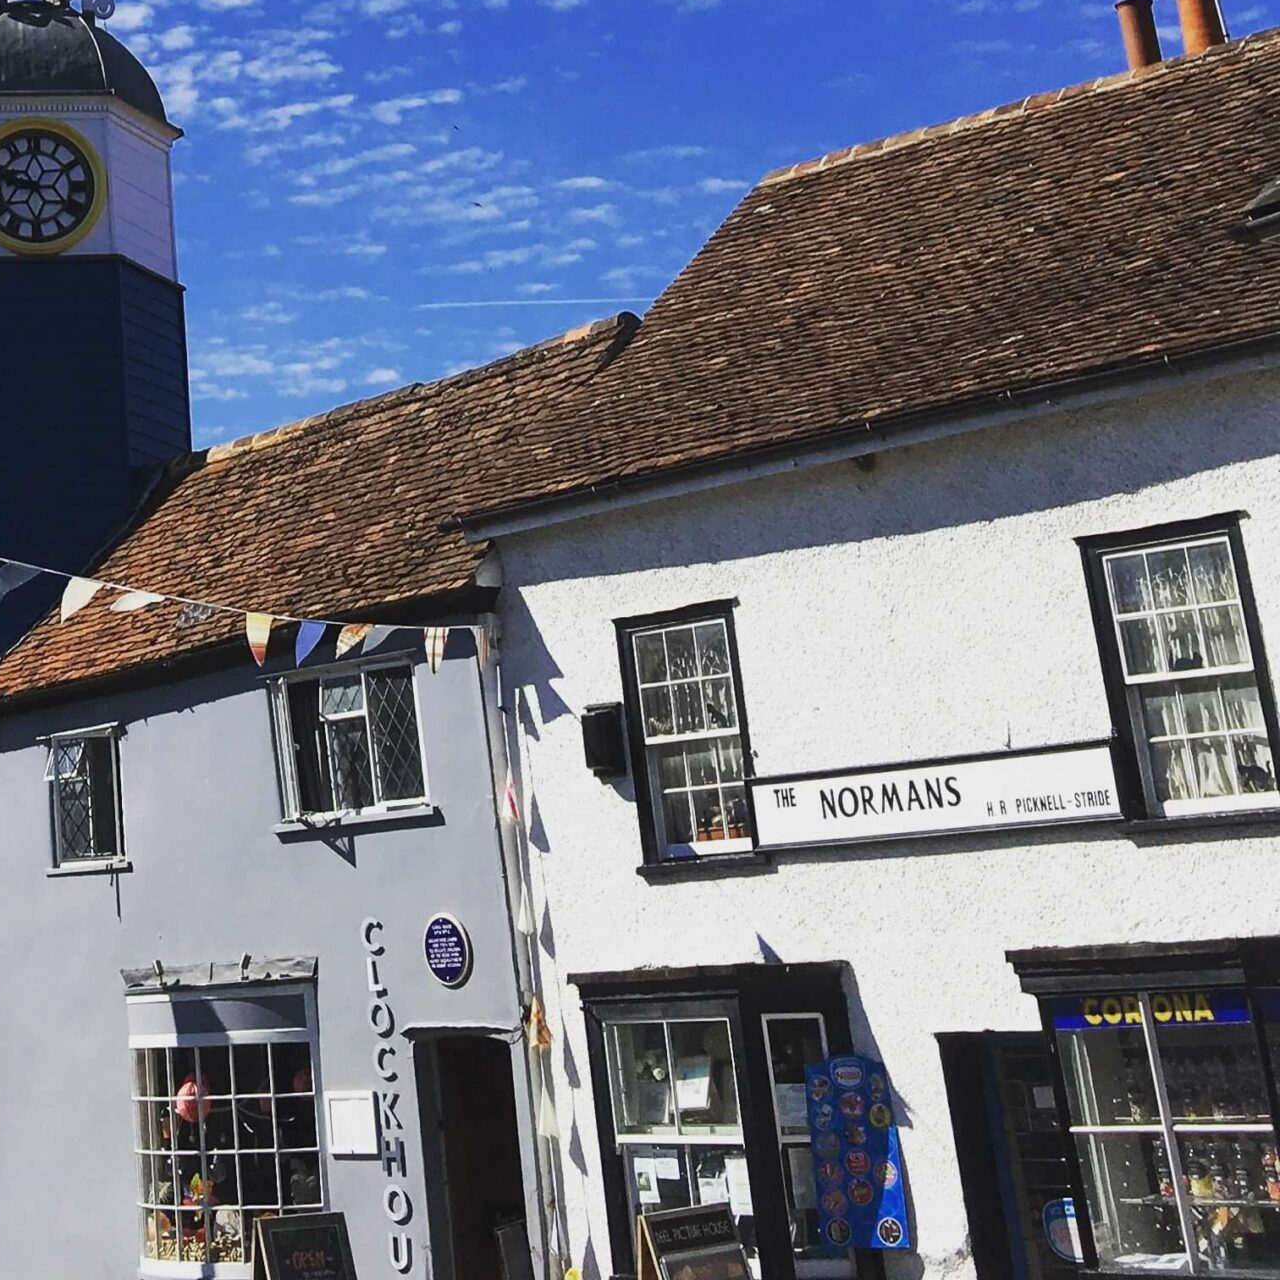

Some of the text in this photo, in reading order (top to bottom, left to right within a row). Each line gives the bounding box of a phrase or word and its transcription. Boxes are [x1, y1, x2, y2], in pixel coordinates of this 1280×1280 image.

[773, 776, 962, 820] THE NORMANS
[986, 789, 1111, 817] H R PICKNELL-STRIDE
[1082, 992, 1215, 1025] CORONA
[702, 1220, 731, 1235] HOUSE
